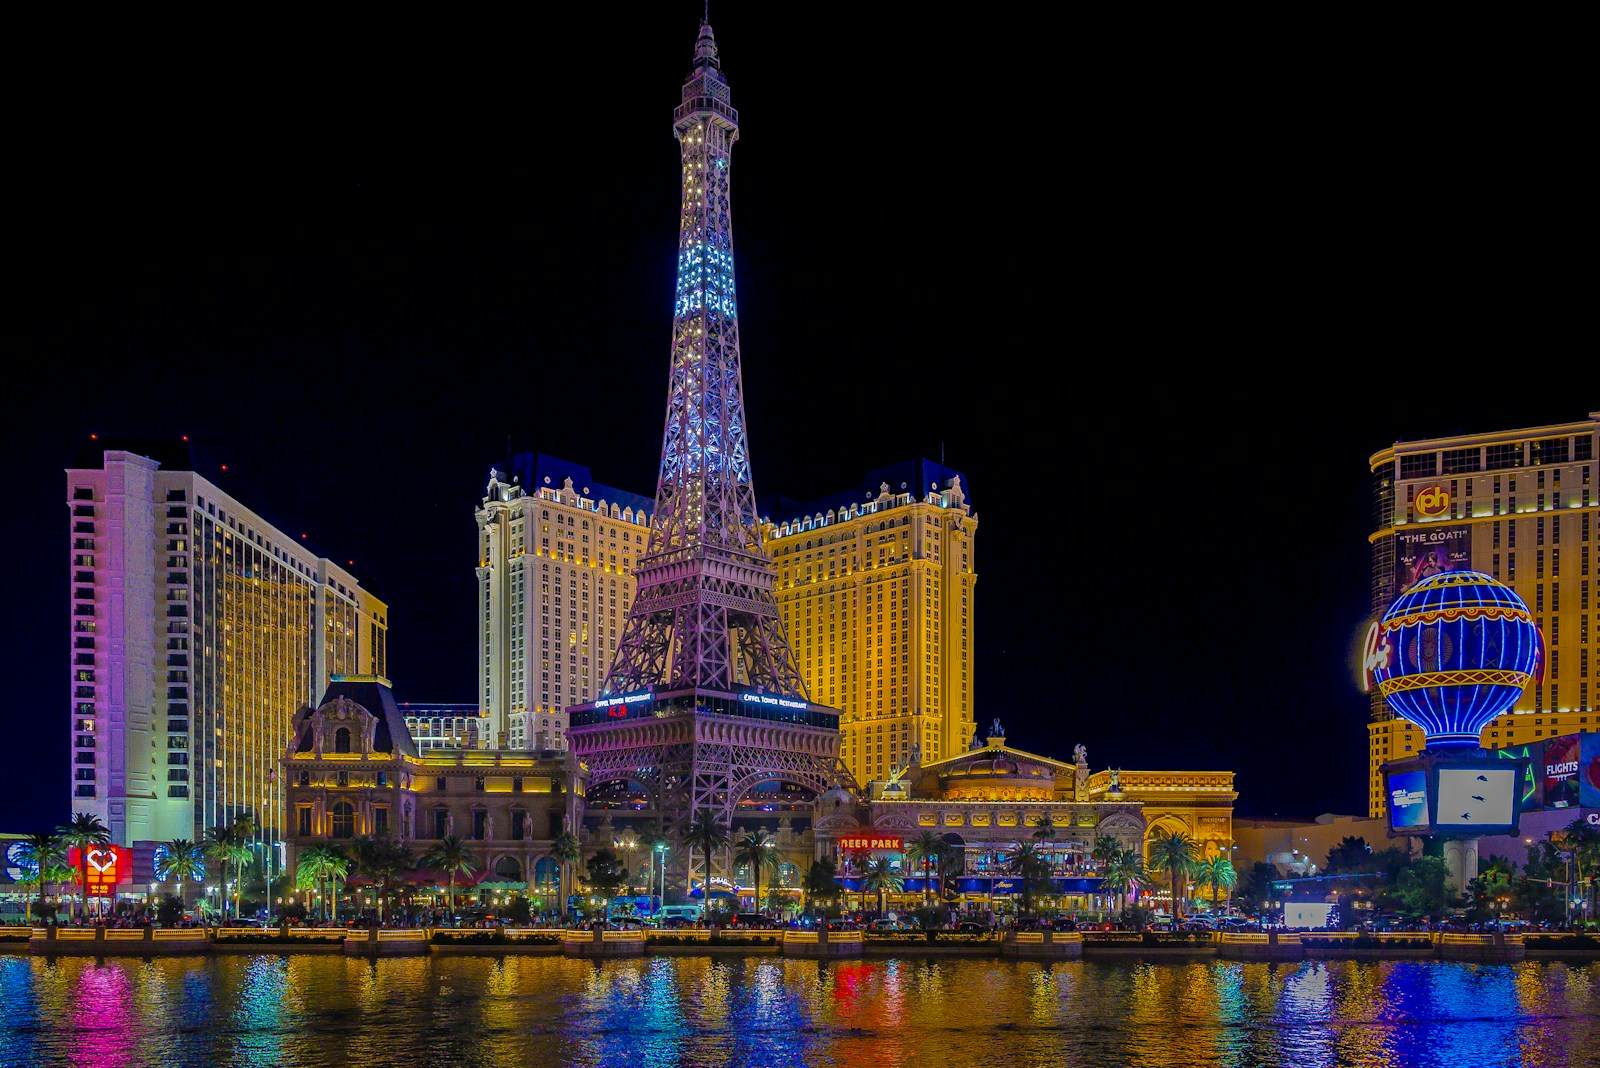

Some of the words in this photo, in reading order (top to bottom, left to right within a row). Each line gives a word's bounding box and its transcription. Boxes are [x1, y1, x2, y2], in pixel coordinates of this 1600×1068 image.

[1420, 486, 1449, 513] ph
[1546, 761, 1579, 775] FLIGHTS
[1586, 813, 1600, 825] C
[841, 839, 868, 848] BEER
[871, 839, 899, 848] PARK
